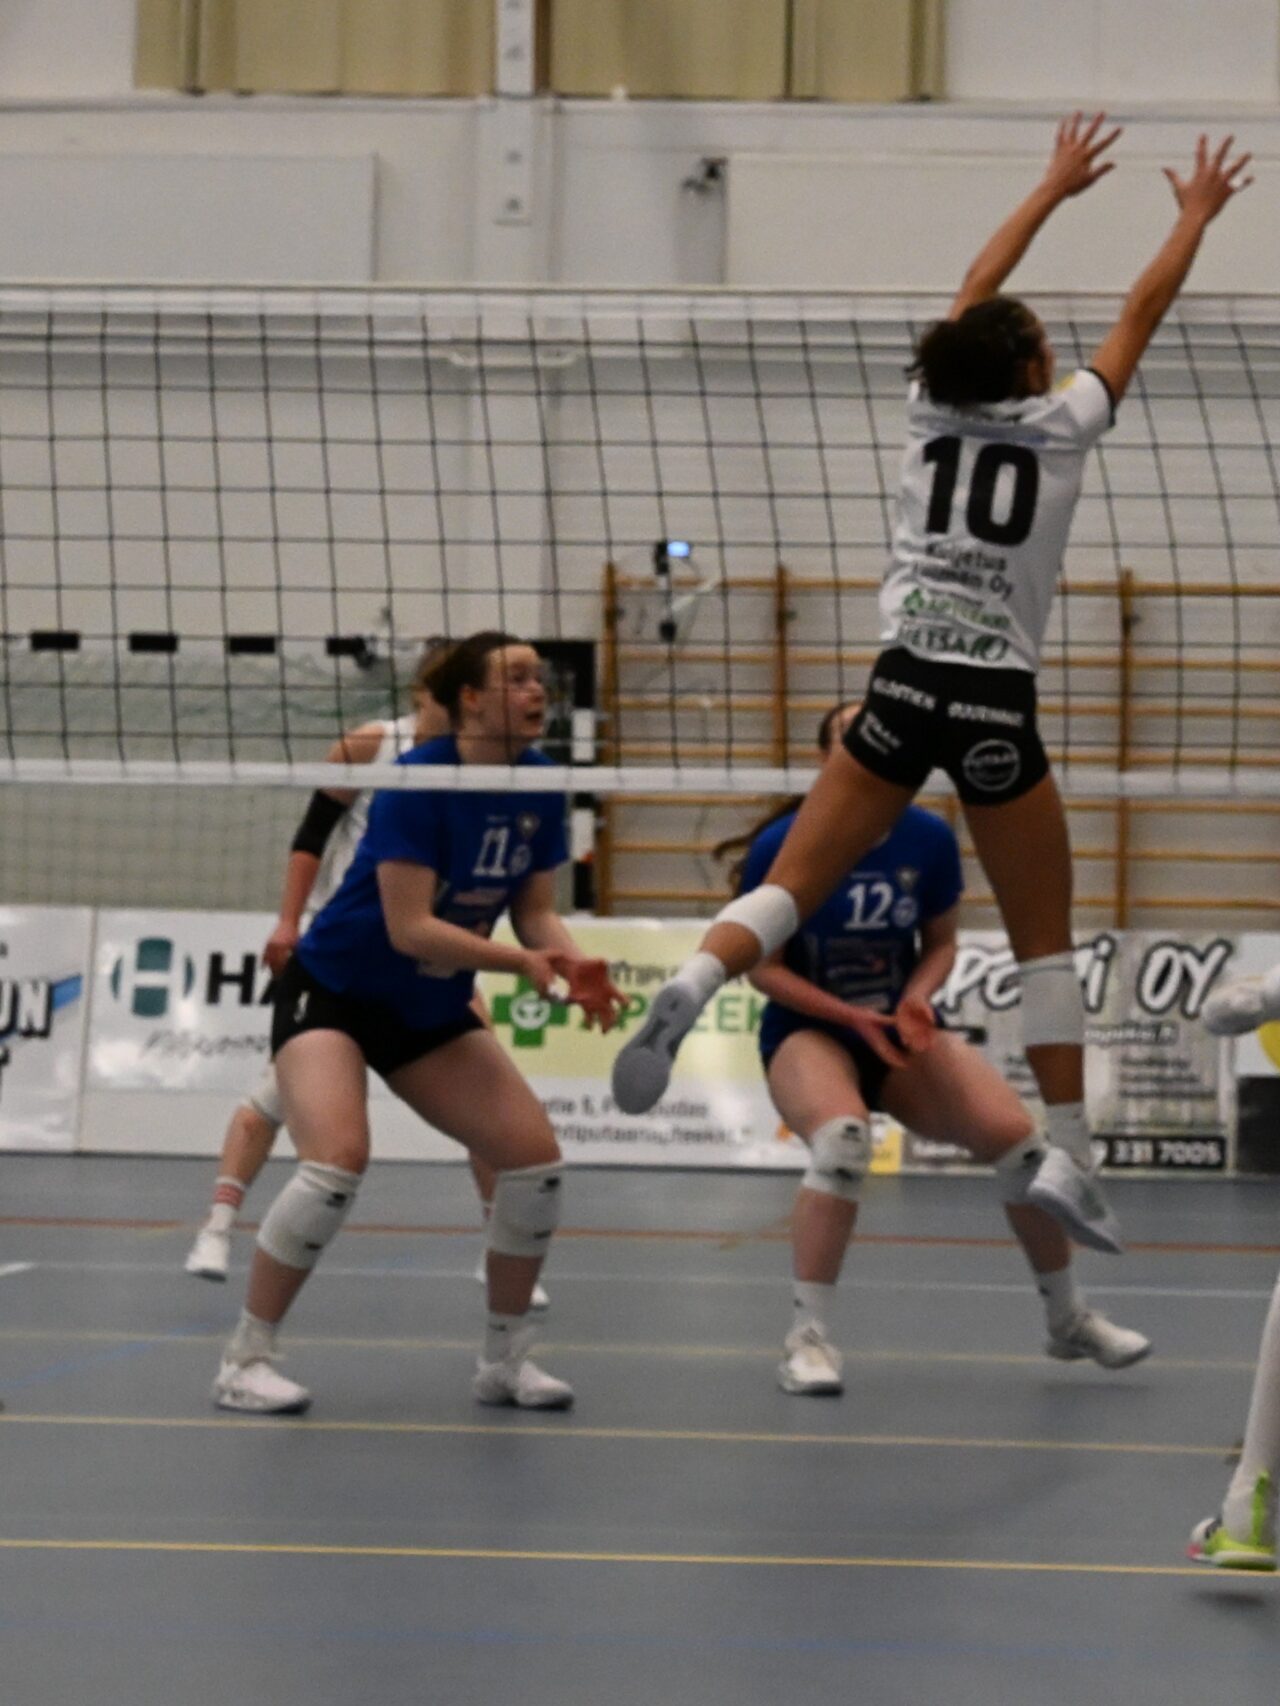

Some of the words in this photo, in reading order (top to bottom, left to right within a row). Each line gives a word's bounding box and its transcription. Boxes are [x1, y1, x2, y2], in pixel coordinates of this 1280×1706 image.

[923, 435, 1040, 547] 10
[844, 881, 895, 930] 12
[1137, 940, 1233, 1019] OY
